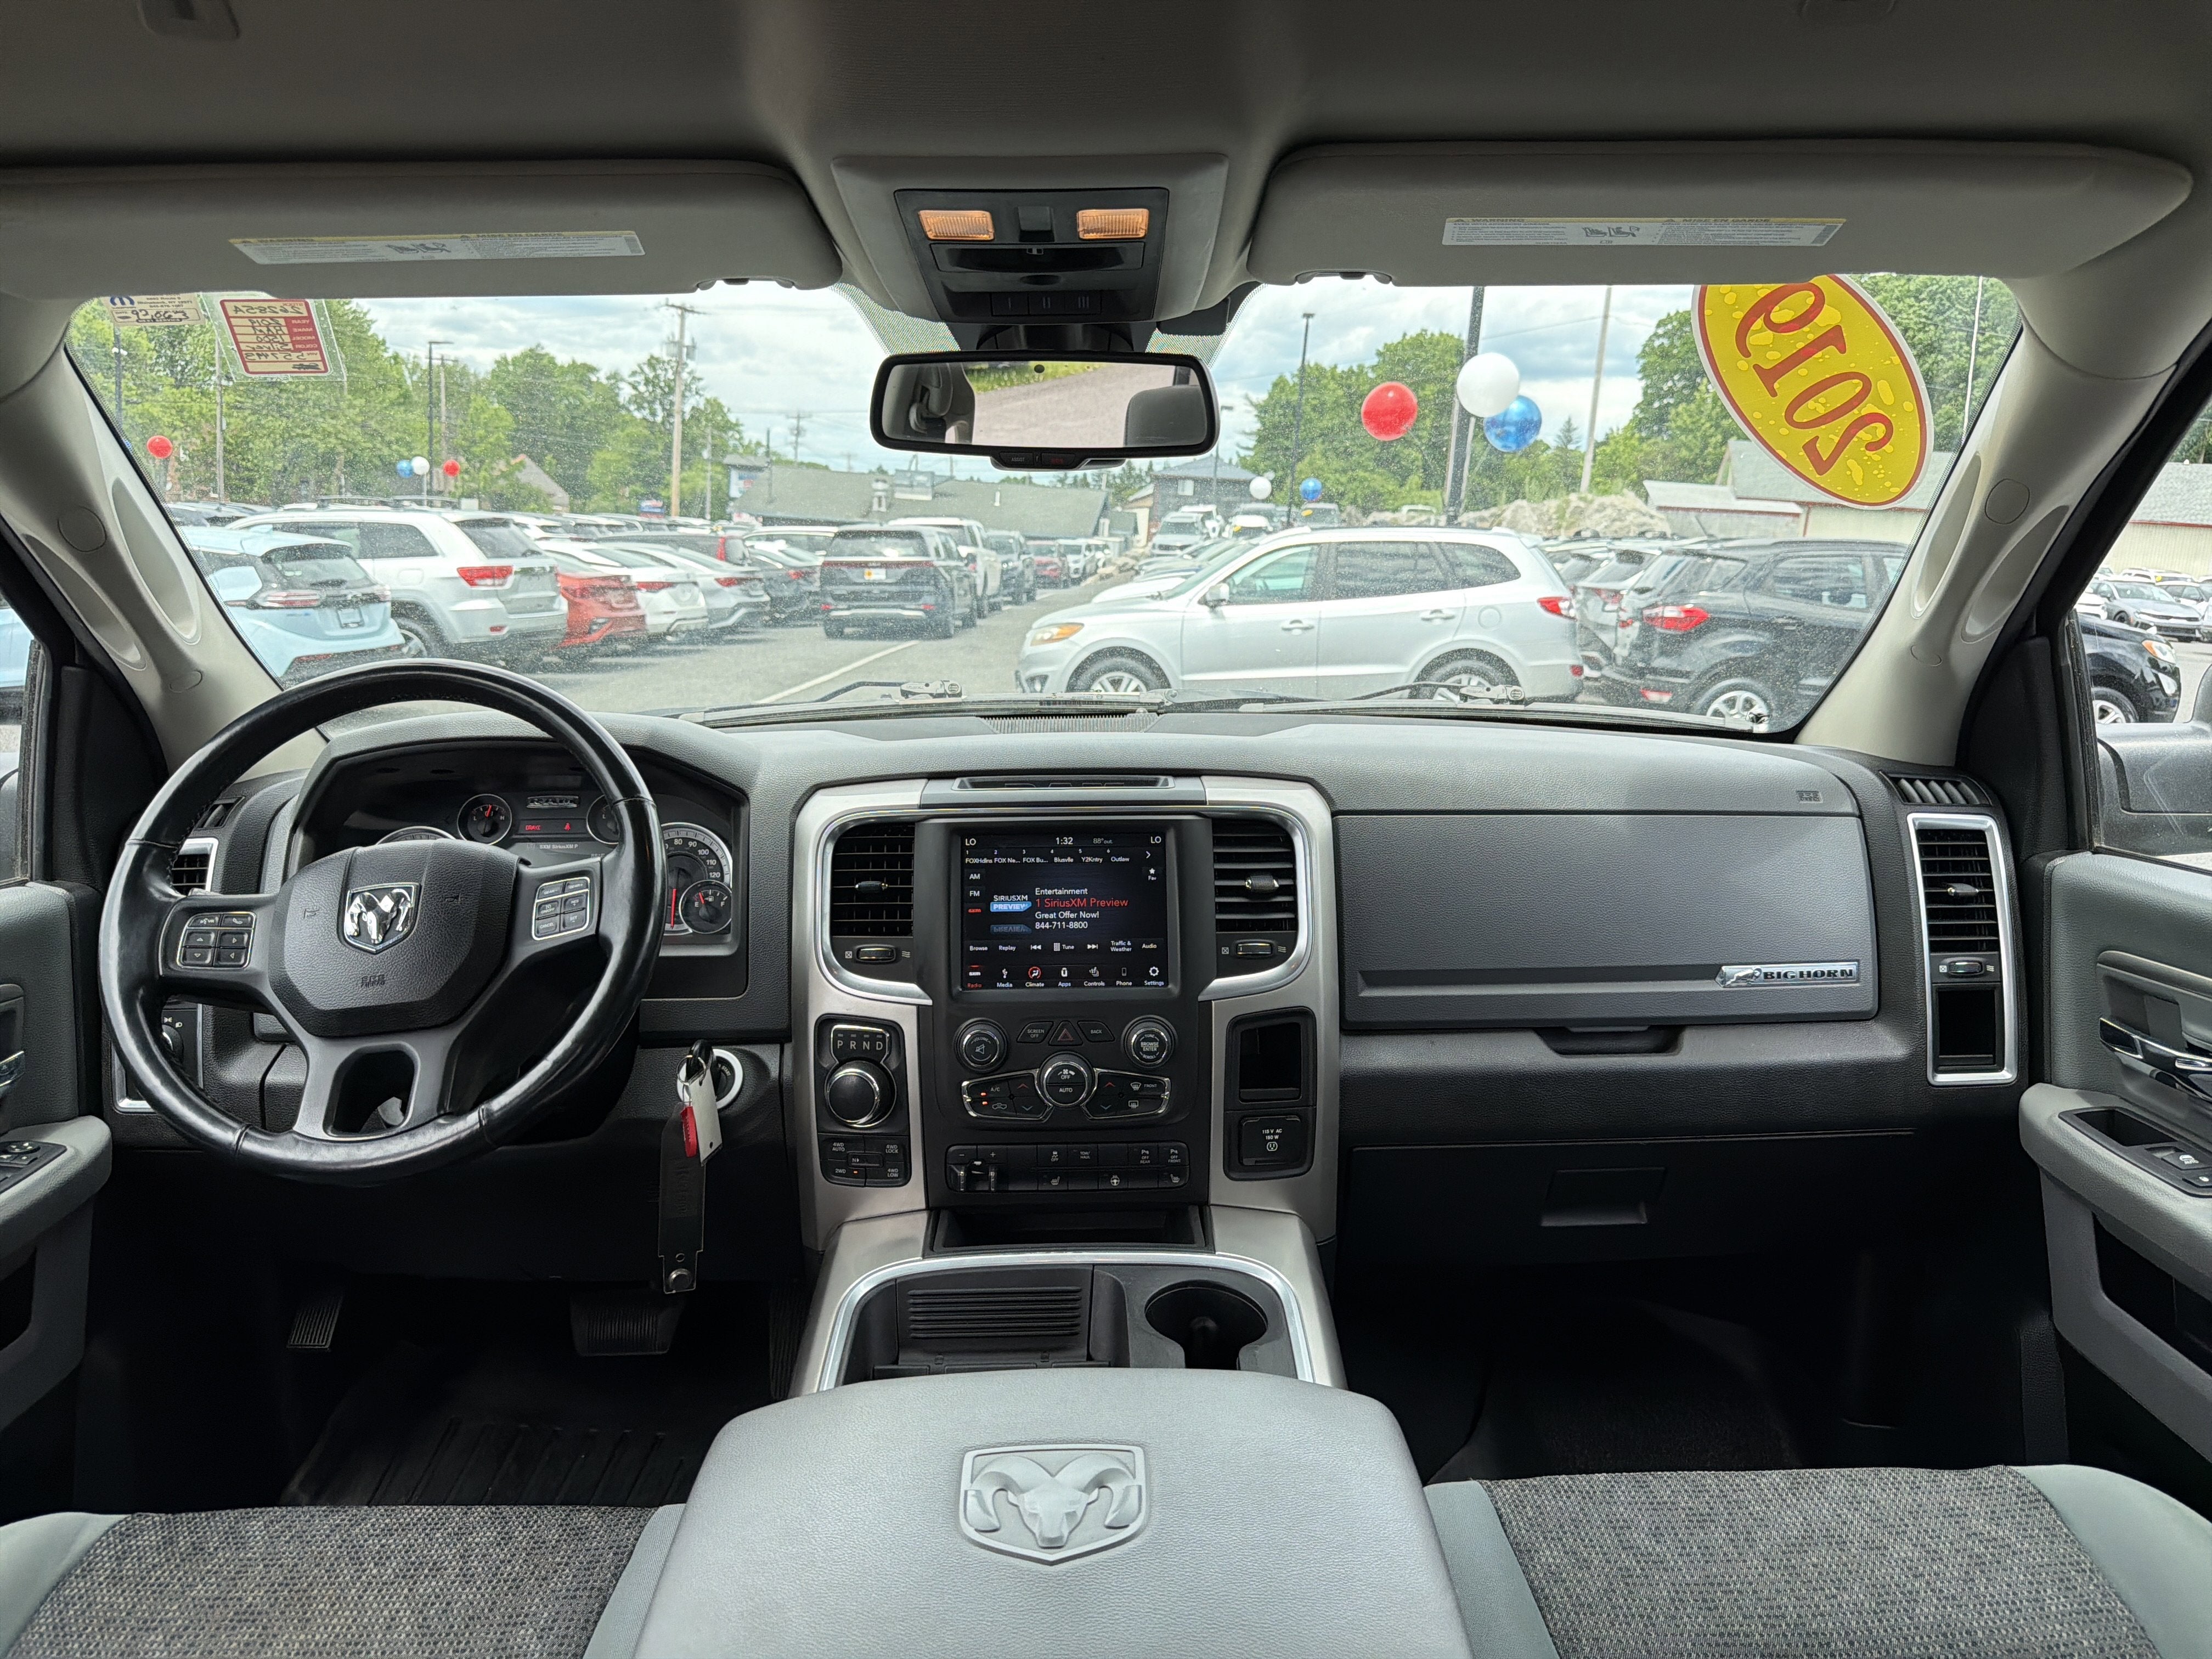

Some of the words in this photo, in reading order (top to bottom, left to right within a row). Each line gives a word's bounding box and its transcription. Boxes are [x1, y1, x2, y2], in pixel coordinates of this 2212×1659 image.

[1056, 837, 1073, 845] 1:32
[1044, 898, 1087, 907] SiriusXM
[1090, 898, 1128, 907] Preview
[1035, 911, 1057, 919] Great
[1058, 911, 1077, 919] Offer
[1035, 921, 1088, 929] 844-711-8800
[837, 1040, 843, 1049] P
[850, 1041, 856, 1049] R
[863, 1041, 870, 1050] N
[876, 1041, 883, 1051] D
